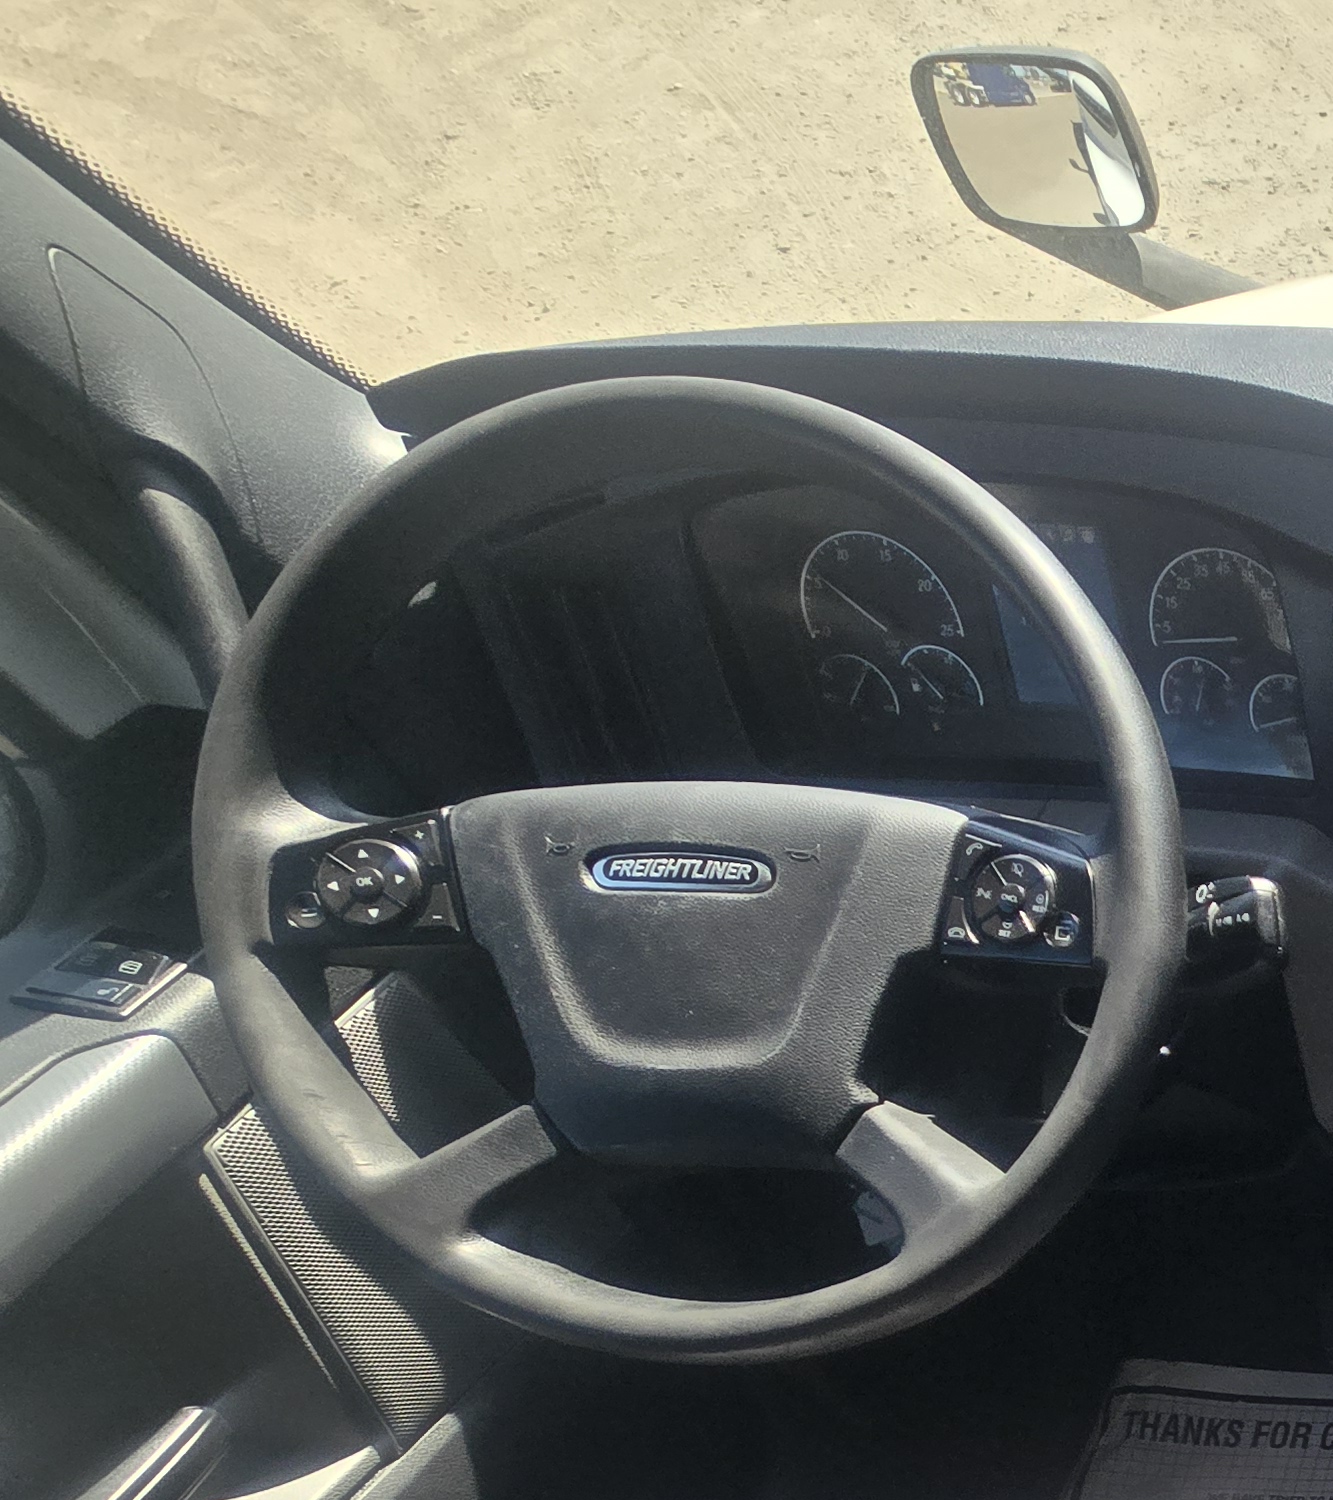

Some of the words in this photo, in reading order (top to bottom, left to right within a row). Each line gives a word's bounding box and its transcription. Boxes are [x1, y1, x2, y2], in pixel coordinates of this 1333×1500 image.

[918, 579, 932, 592] 20
[1176, 577, 1191, 590] 25
[1165, 596, 1178, 609] 15
[941, 624, 954, 637] 25
[1163, 620, 1172, 633] 5
[608, 857, 752, 881] FREIGHTLINER
[355, 876, 374, 887] OK
[1123, 1410, 1242, 1448] THANKS
[1250, 1419, 1313, 1449] FOR
